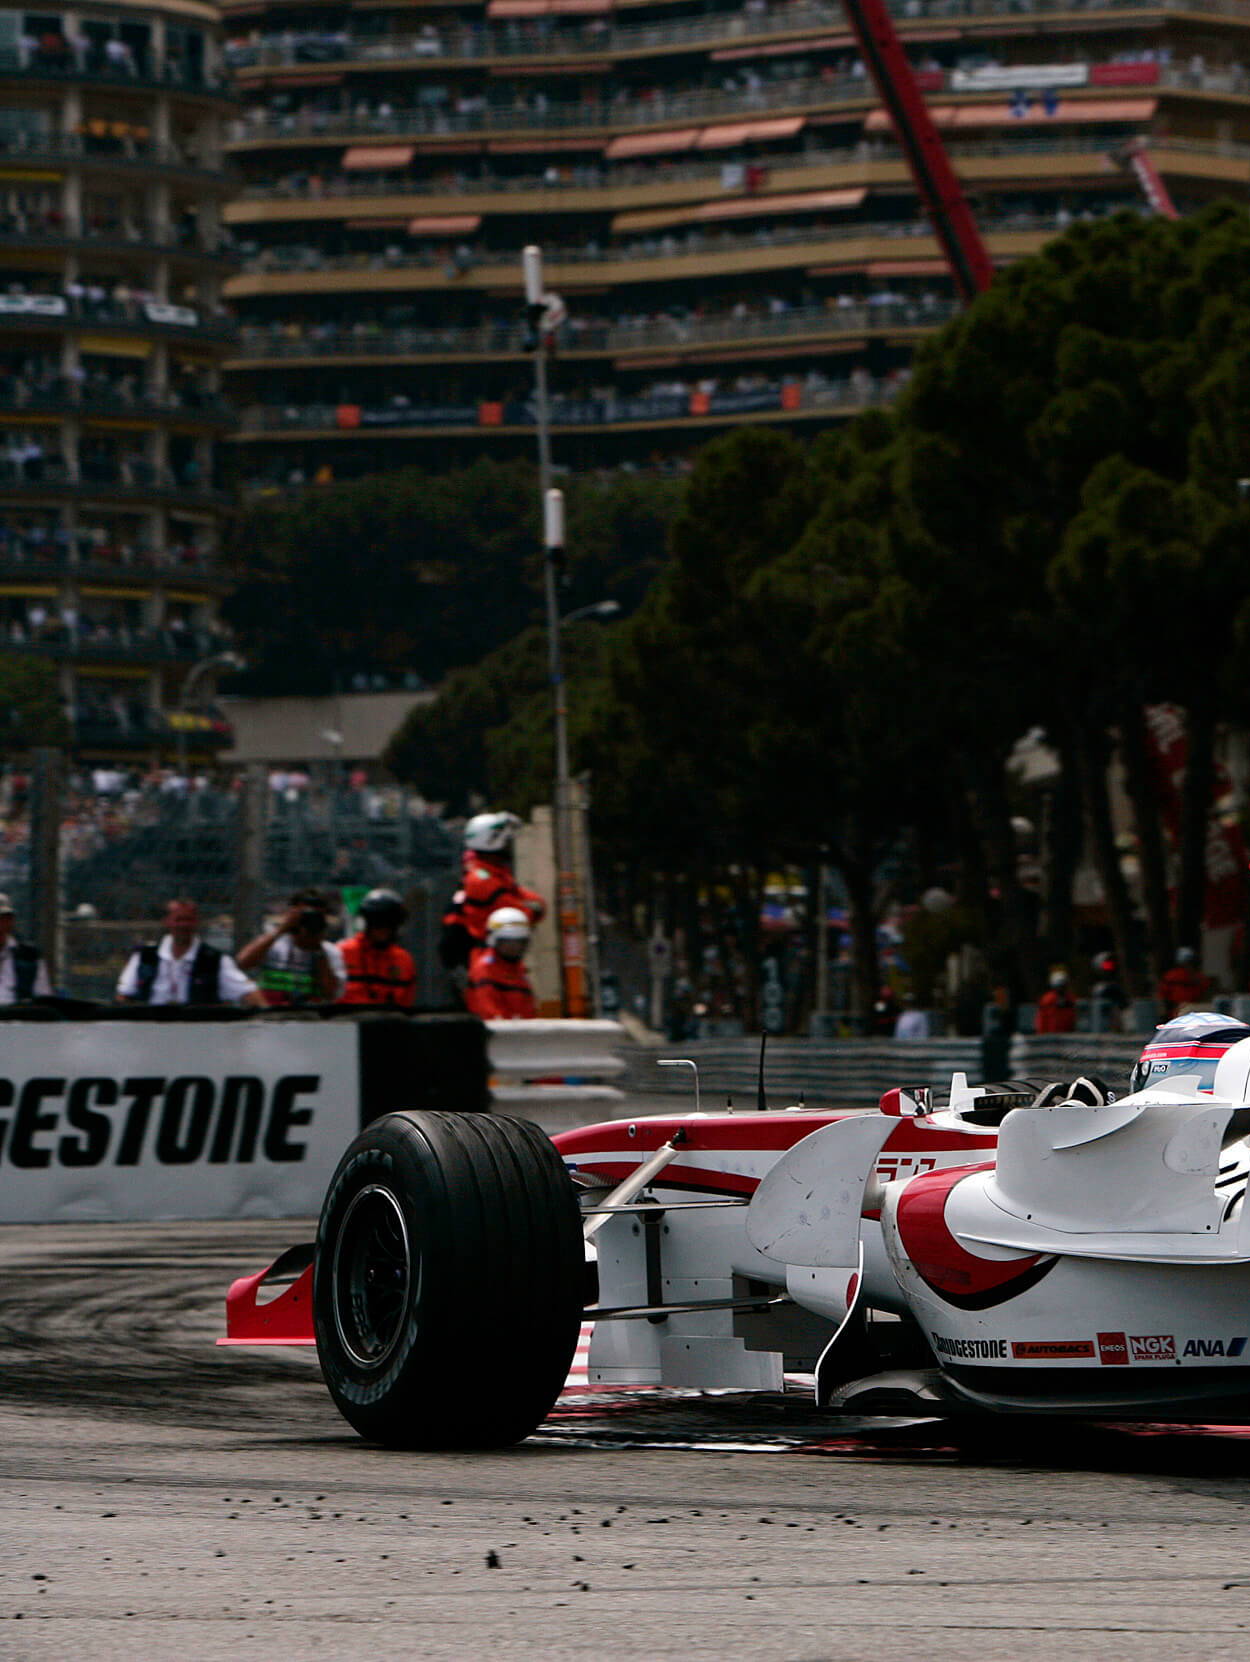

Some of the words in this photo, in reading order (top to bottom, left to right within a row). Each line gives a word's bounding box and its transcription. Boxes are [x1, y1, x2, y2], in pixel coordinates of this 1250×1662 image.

[0, 1076, 320, 1167] ESTONE
[1101, 1344, 1125, 1352] ENEOS
[1129, 1336, 1174, 1354] NGK
[1183, 1340, 1225, 1357] ANA
